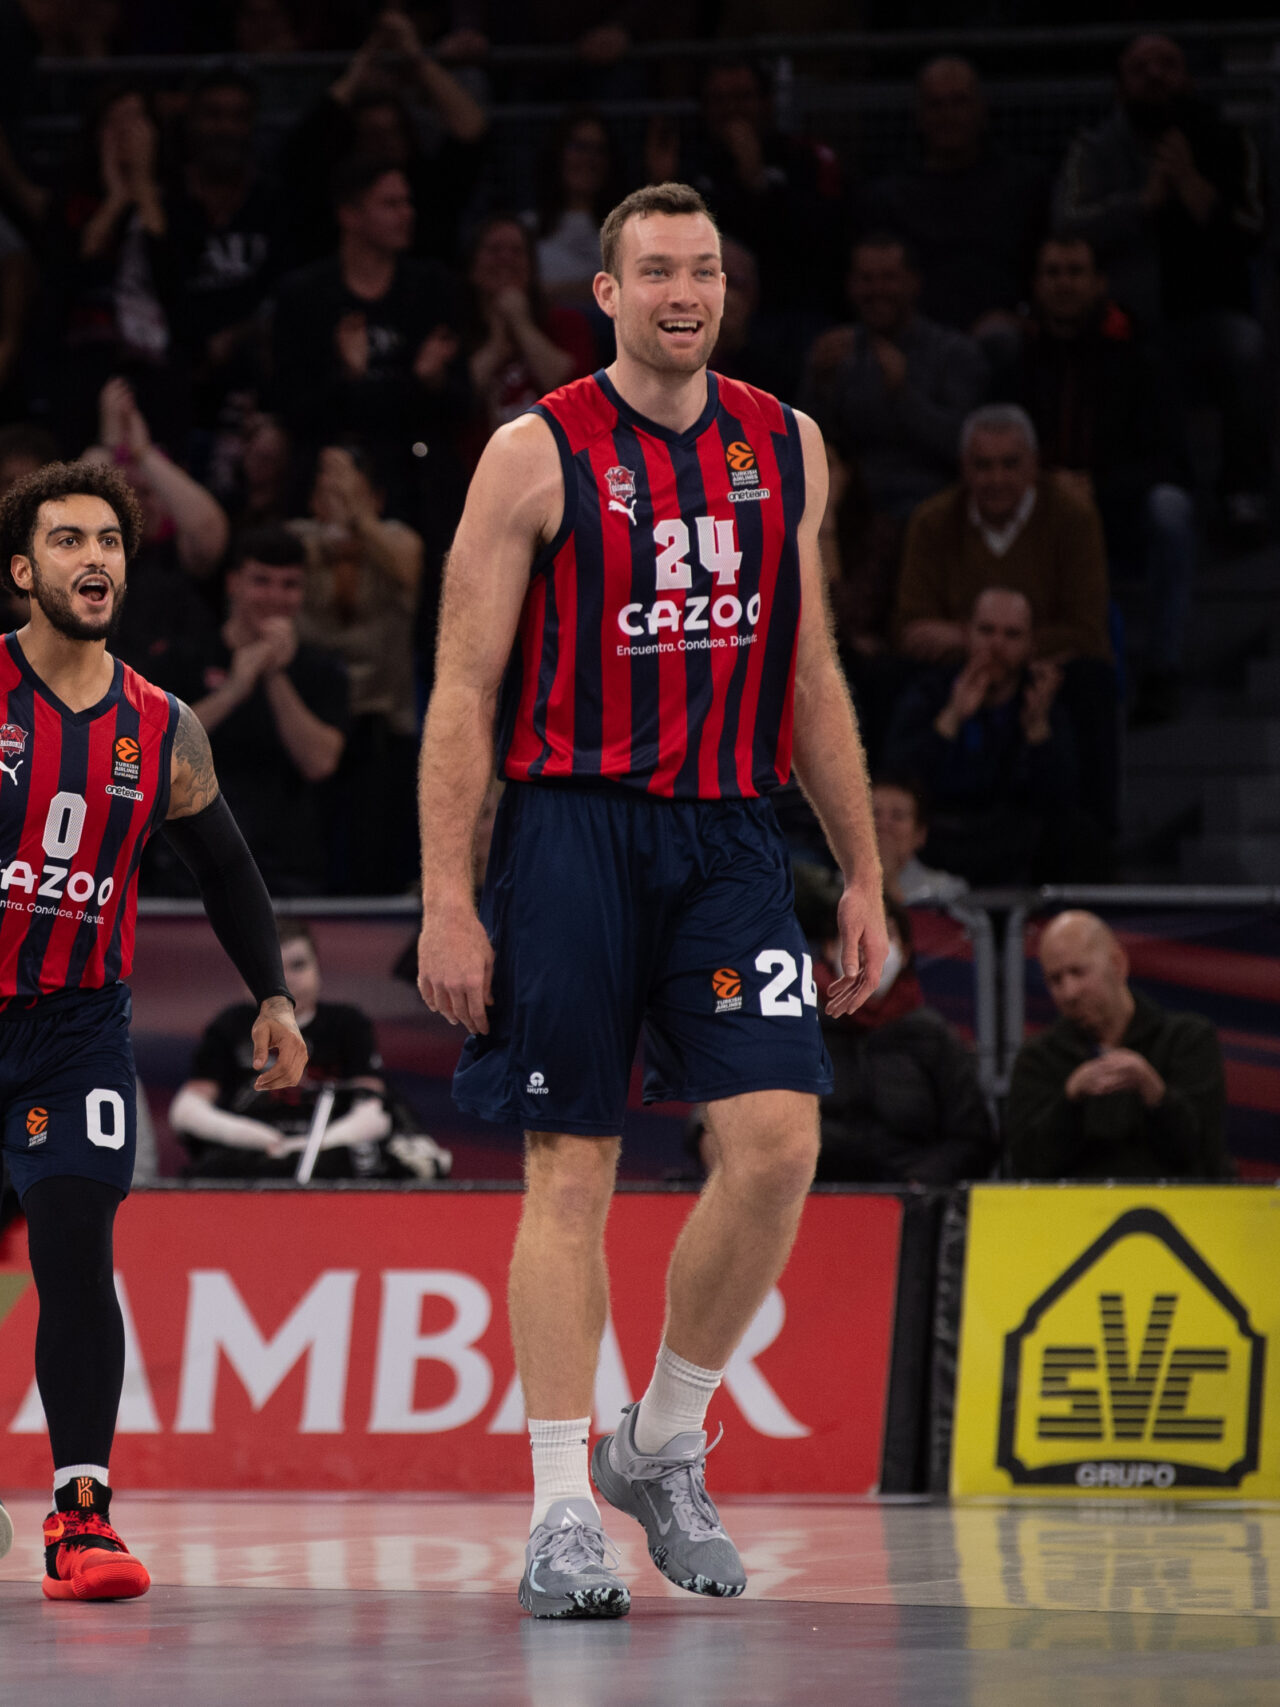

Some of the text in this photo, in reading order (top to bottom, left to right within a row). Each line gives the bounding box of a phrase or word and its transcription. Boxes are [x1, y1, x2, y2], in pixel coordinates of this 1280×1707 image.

[652, 516, 743, 591] 24
[617, 592, 761, 636] CAZOO
[114, 761, 139, 769] TURKISH
[114, 766, 139, 775] AIRLINES
[41, 791, 88, 860] 0
[85, 1088, 125, 1150] 0
[1075, 1462, 1176, 1488] GRUPO
